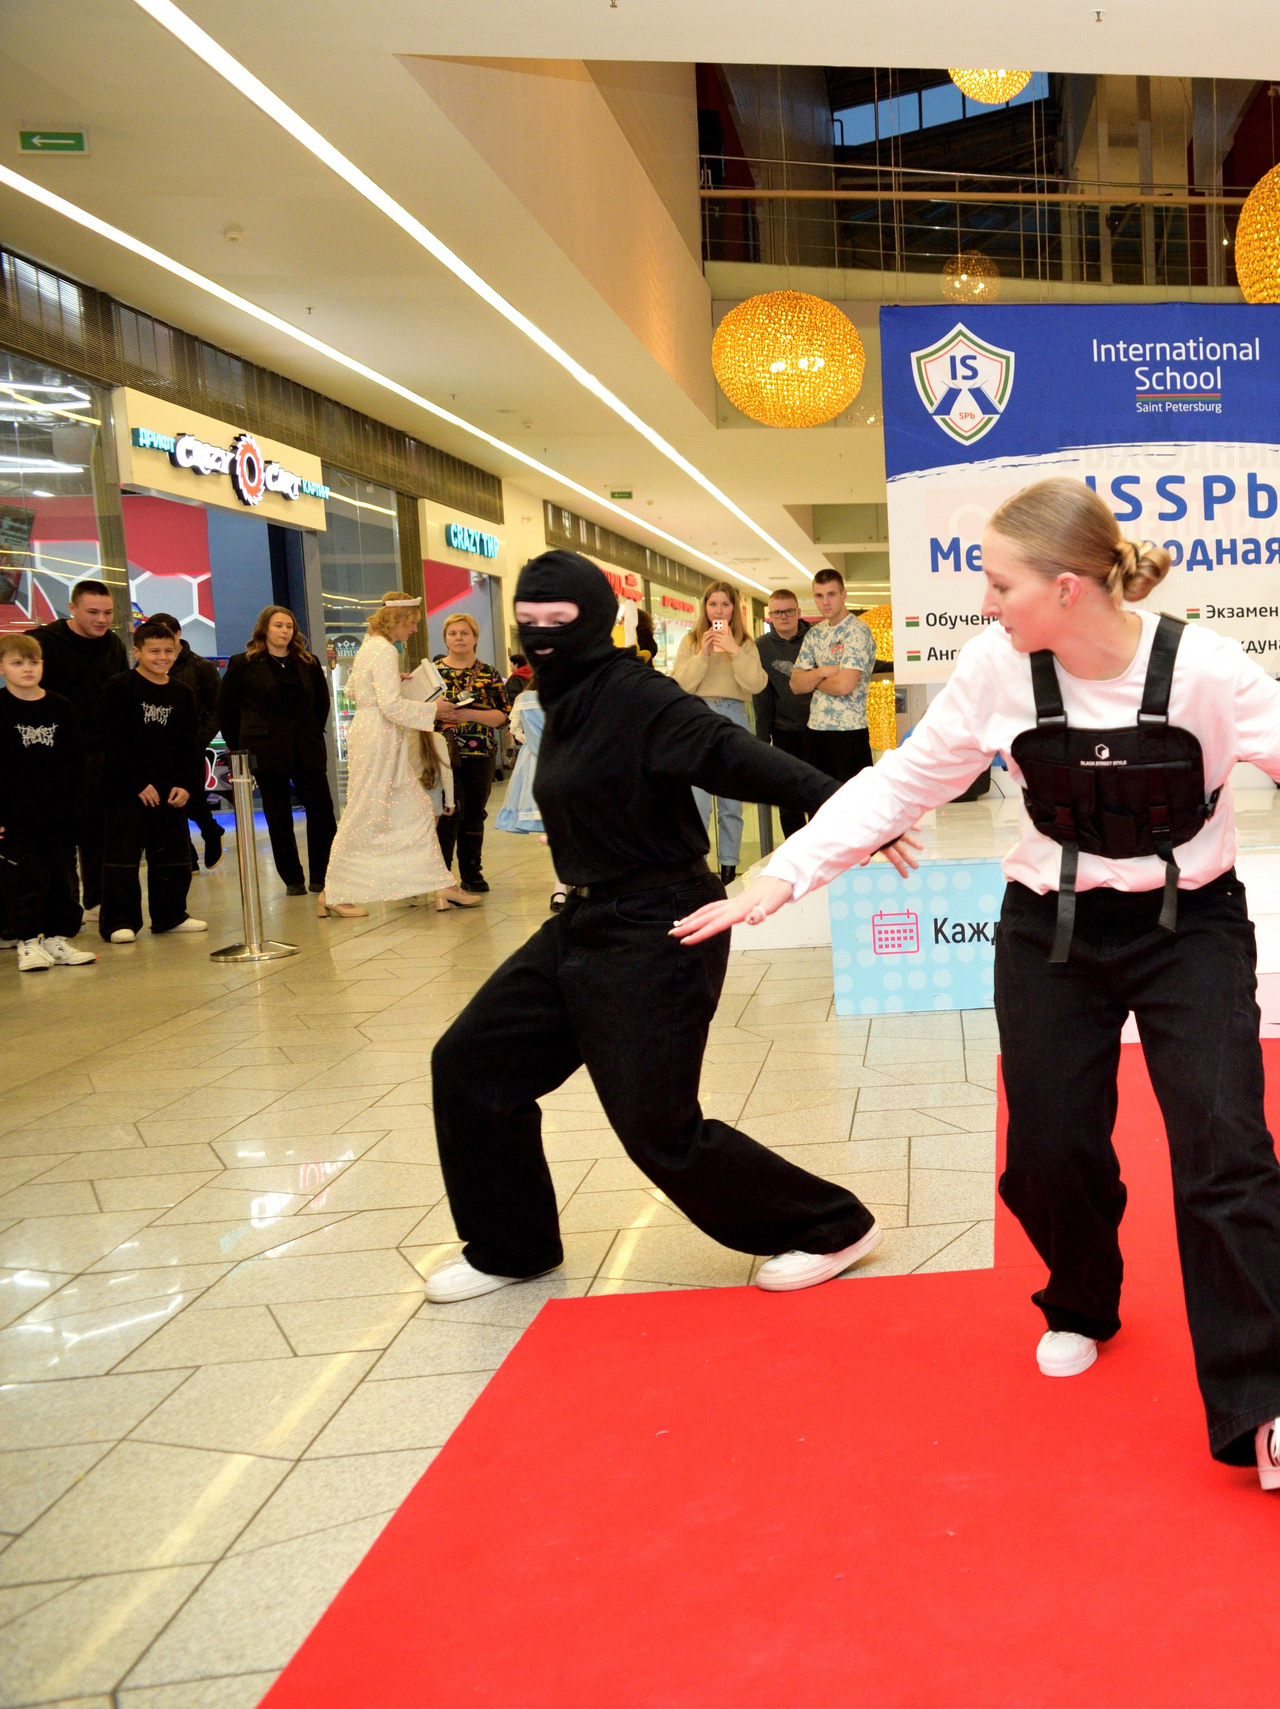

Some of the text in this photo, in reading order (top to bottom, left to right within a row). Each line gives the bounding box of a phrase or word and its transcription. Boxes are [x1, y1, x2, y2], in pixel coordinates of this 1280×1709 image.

[1093, 337, 1260, 362] International
[950, 354, 979, 381] IS
[1135, 366, 1222, 390] School
[959, 412, 975, 420] SPb
[1136, 401, 1222, 414] Saint Petersburg
[450, 523, 481, 553] CRAZY
